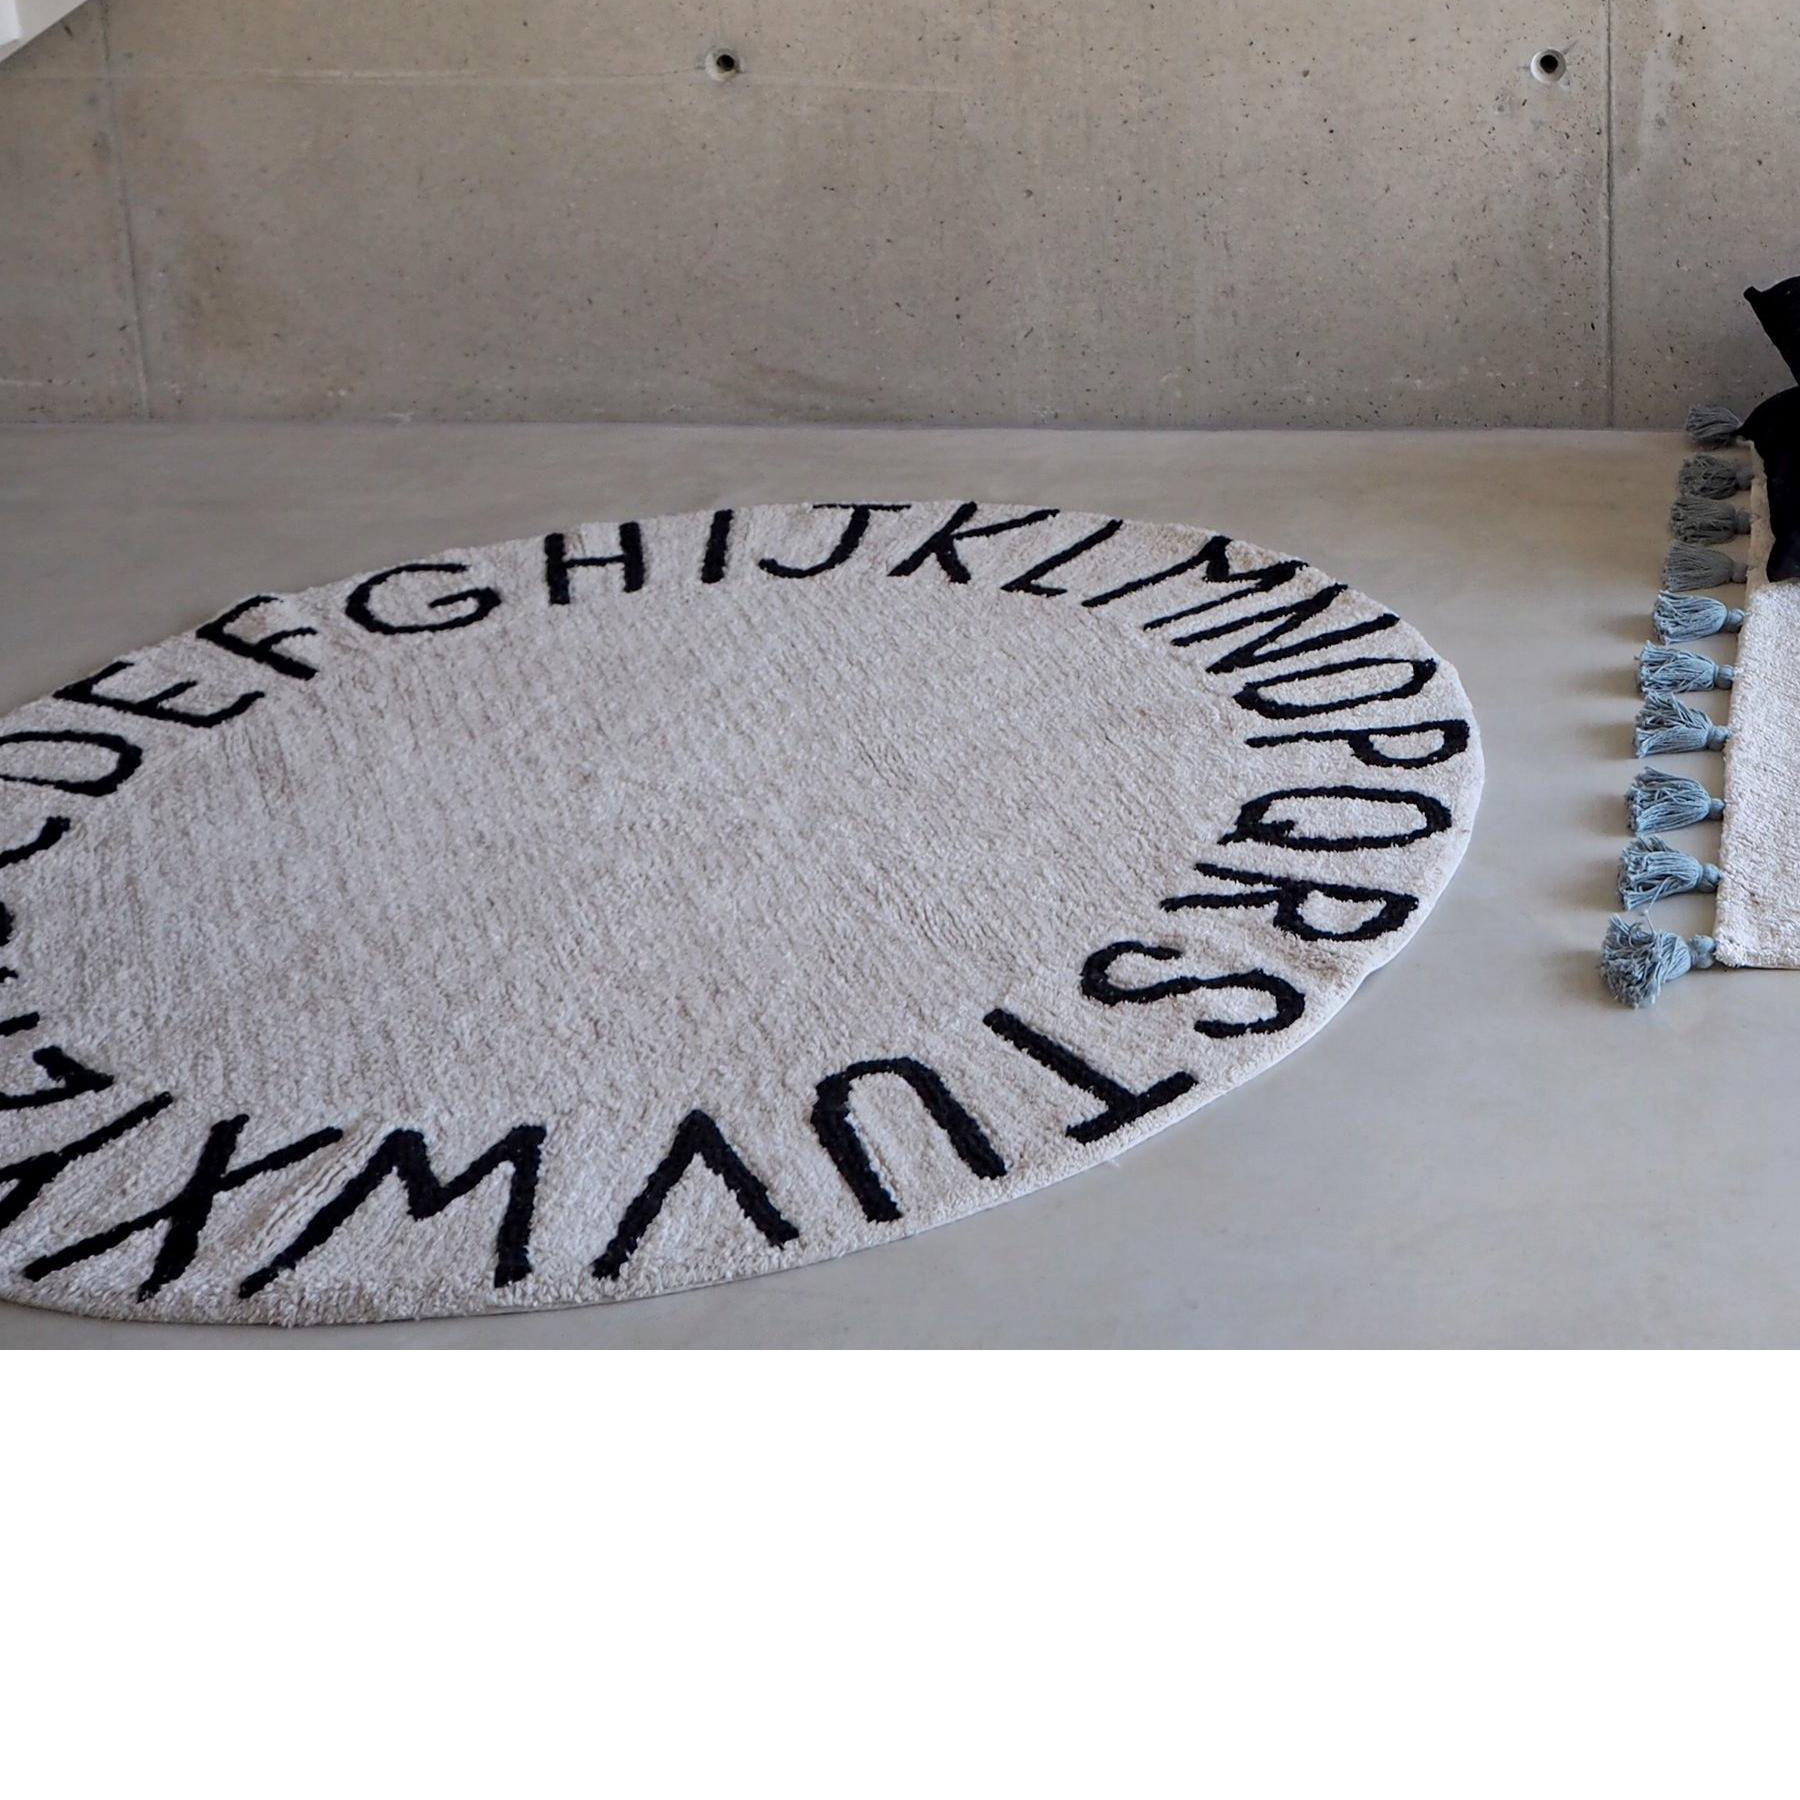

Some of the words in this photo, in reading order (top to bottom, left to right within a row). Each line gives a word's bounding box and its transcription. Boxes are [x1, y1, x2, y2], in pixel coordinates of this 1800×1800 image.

[345, 562, 505, 636] G
[544, 520, 646, 606] H
[1079, 939, 1306, 1039] S
[982, 1006, 1199, 1145] T
[591, 1109, 800, 1282] V
[808, 1056, 1008, 1223] U
